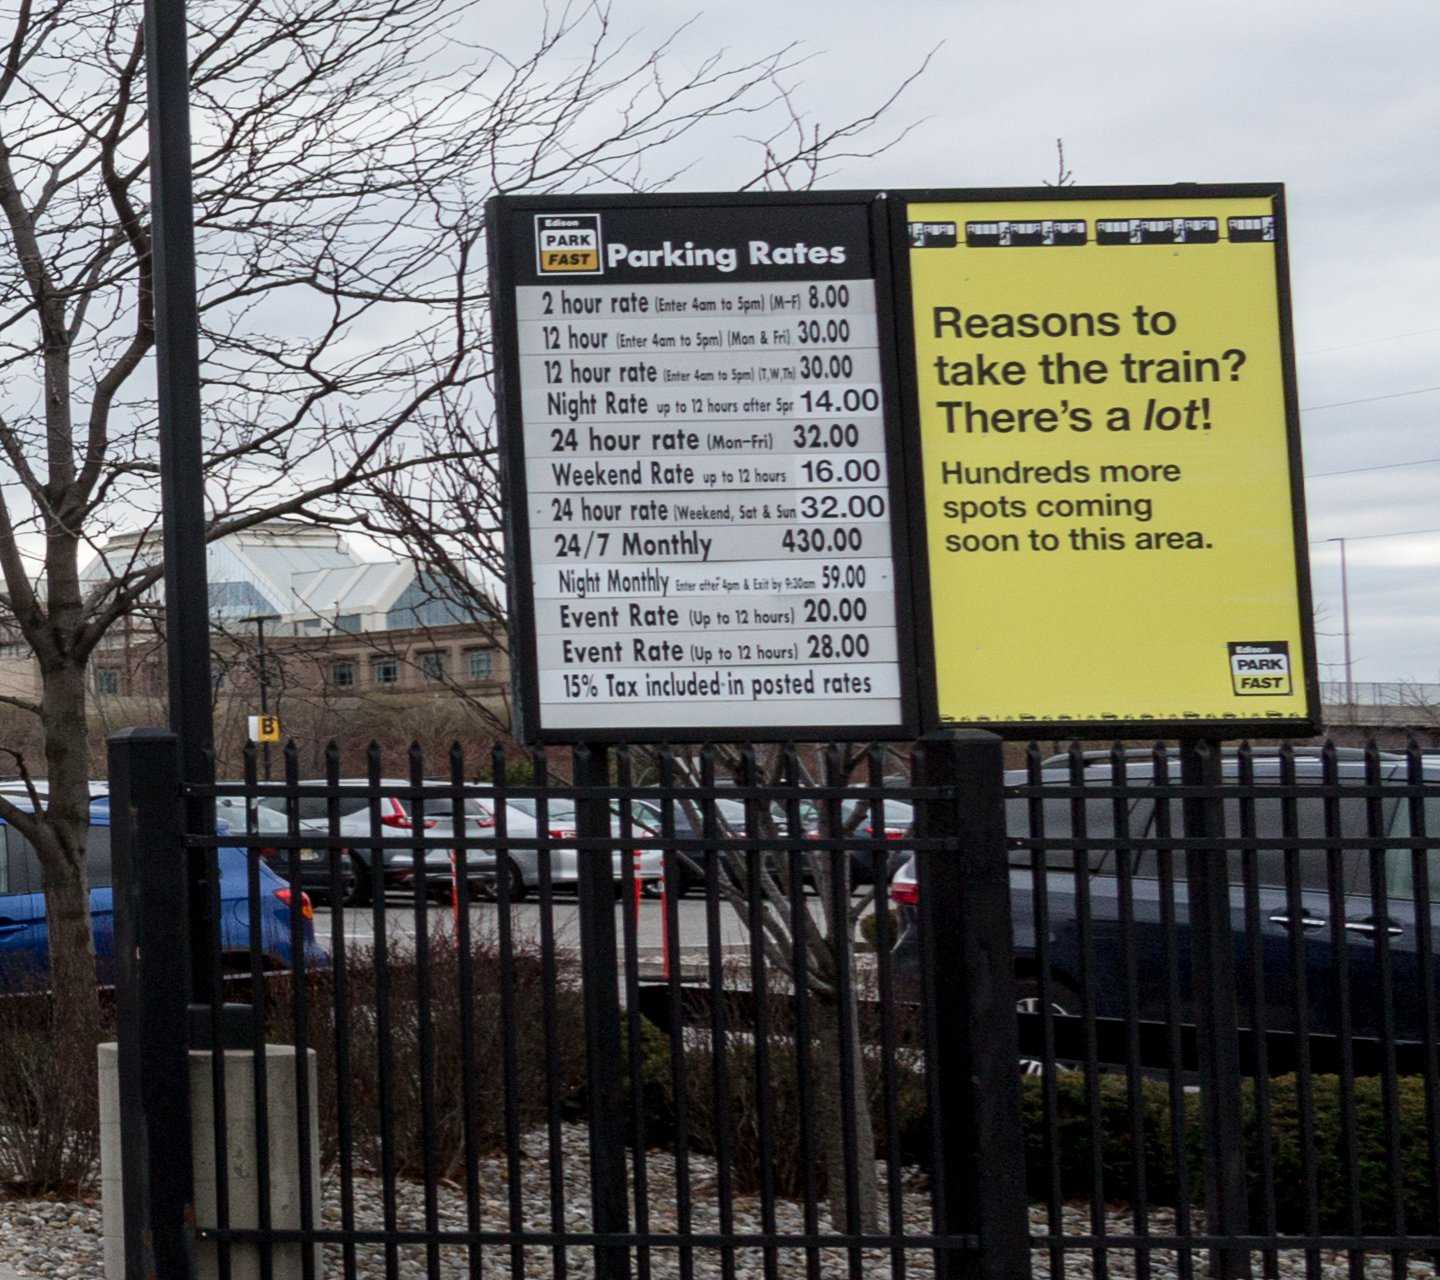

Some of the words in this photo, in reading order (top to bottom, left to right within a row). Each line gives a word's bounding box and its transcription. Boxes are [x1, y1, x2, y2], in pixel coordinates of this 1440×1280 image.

[546, 235, 591, 246] PARK
[548, 254, 591, 266] FAST
[607, 241, 736, 272] Parking
[749, 240, 846, 265] Rates
[542, 291, 553, 315] 2
[561, 289, 601, 314] hour
[611, 292, 649, 313] rate
[655, 296, 687, 312] (Enter
[692, 297, 717, 311] 4am
[721, 298, 733, 311] to
[737, 294, 765, 315] 5pm)
[809, 285, 849, 309] 8.00
[543, 327, 560, 350] 12
[569, 324, 608, 349] hour
[616, 334, 648, 350] (Enter
[652, 333, 676, 347] 4am
[680, 334, 691, 347] to
[696, 330, 722, 350] 5pm)
[727, 330, 755, 348] (Mon
[760, 330, 768, 345] &
[798, 320, 850, 345] 30.00
[933, 306, 1120, 338] Reasons
[1132, 305, 1177, 336] to
[544, 361, 562, 384] 12
[570, 359, 610, 384] hour
[619, 362, 657, 383] rate
[663, 369, 690, 383] (Enter
[694, 369, 714, 381] 4am
[718, 370, 728, 381] to
[731, 367, 754, 384] 5pm)
[800, 355, 853, 380] 30.00
[934, 353, 1026, 386] take
[1039, 352, 1108, 384] the
[1121, 349, 1247, 383] train?
[548, 391, 596, 422] Night
[606, 391, 648, 414] Rate
[656, 402, 670, 417] up
[676, 401, 687, 413] to
[692, 399, 703, 413] 12
[708, 398, 738, 413] hours
[743, 398, 771, 413] after
[800, 389, 879, 413] 14.00
[936, 399, 1092, 434] There's
[1106, 407, 1130, 432] a
[1144, 397, 1212, 431] lot!
[551, 428, 578, 452] 24
[589, 427, 640, 451] hour
[652, 429, 700, 450] rate
[794, 424, 859, 448] 32.00
[552, 461, 642, 486] Weekend
[651, 461, 694, 485] Rate
[703, 472, 717, 488] up
[722, 471, 734, 483] to
[738, 468, 750, 483] 12
[754, 468, 787, 483] hours
[801, 459, 880, 483] 16.00
[941, 460, 1090, 484] Hundreds
[1100, 462, 1181, 483] more
[552, 498, 573, 521] 24
[581, 497, 621, 521] hour
[630, 499, 669, 521] rate
[739, 505, 758, 519] Sat
[763, 505, 771, 519] &
[776, 504, 797, 519] Sun
[800, 495, 885, 519] 32.00
[943, 496, 1027, 523] spots
[1036, 493, 1153, 522] coming
[554, 533, 610, 559] 24/7
[622, 530, 712, 562] Monthly
[782, 528, 862, 553] 430.00
[945, 531, 1019, 552] soon
[1028, 529, 1060, 551] to
[1068, 527, 1126, 550] this
[1135, 529, 1213, 550] area.
[559, 570, 600, 598] Night
[608, 568, 669, 597] Monthly
[743, 578, 750, 590] &
[772, 578, 782, 592] by
[822, 565, 866, 589] 59.00
[560, 604, 619, 629] Event
[629, 603, 679, 627] Rate
[689, 609, 711, 630] (Up
[717, 610, 729, 624] to
[736, 610, 749, 624] 12
[754, 607, 795, 625] hours)
[804, 597, 867, 623] 20.00
[562, 640, 622, 664] Event
[633, 638, 683, 662] Rate
[690, 645, 712, 665] (Up
[719, 646, 732, 660] to
[738, 646, 752, 660] 12
[757, 642, 799, 661] hours)
[807, 634, 869, 658] 28.00
[1237, 659, 1284, 670] PARK
[563, 674, 598, 698] 15%
[606, 675, 638, 697] Tax
[646, 672, 720, 696] included
[728, 672, 744, 695] in
[752, 670, 815, 701] posted
[823, 671, 872, 694] rates
[1241, 677, 1283, 689] FAST
[262, 718, 274, 734] B
